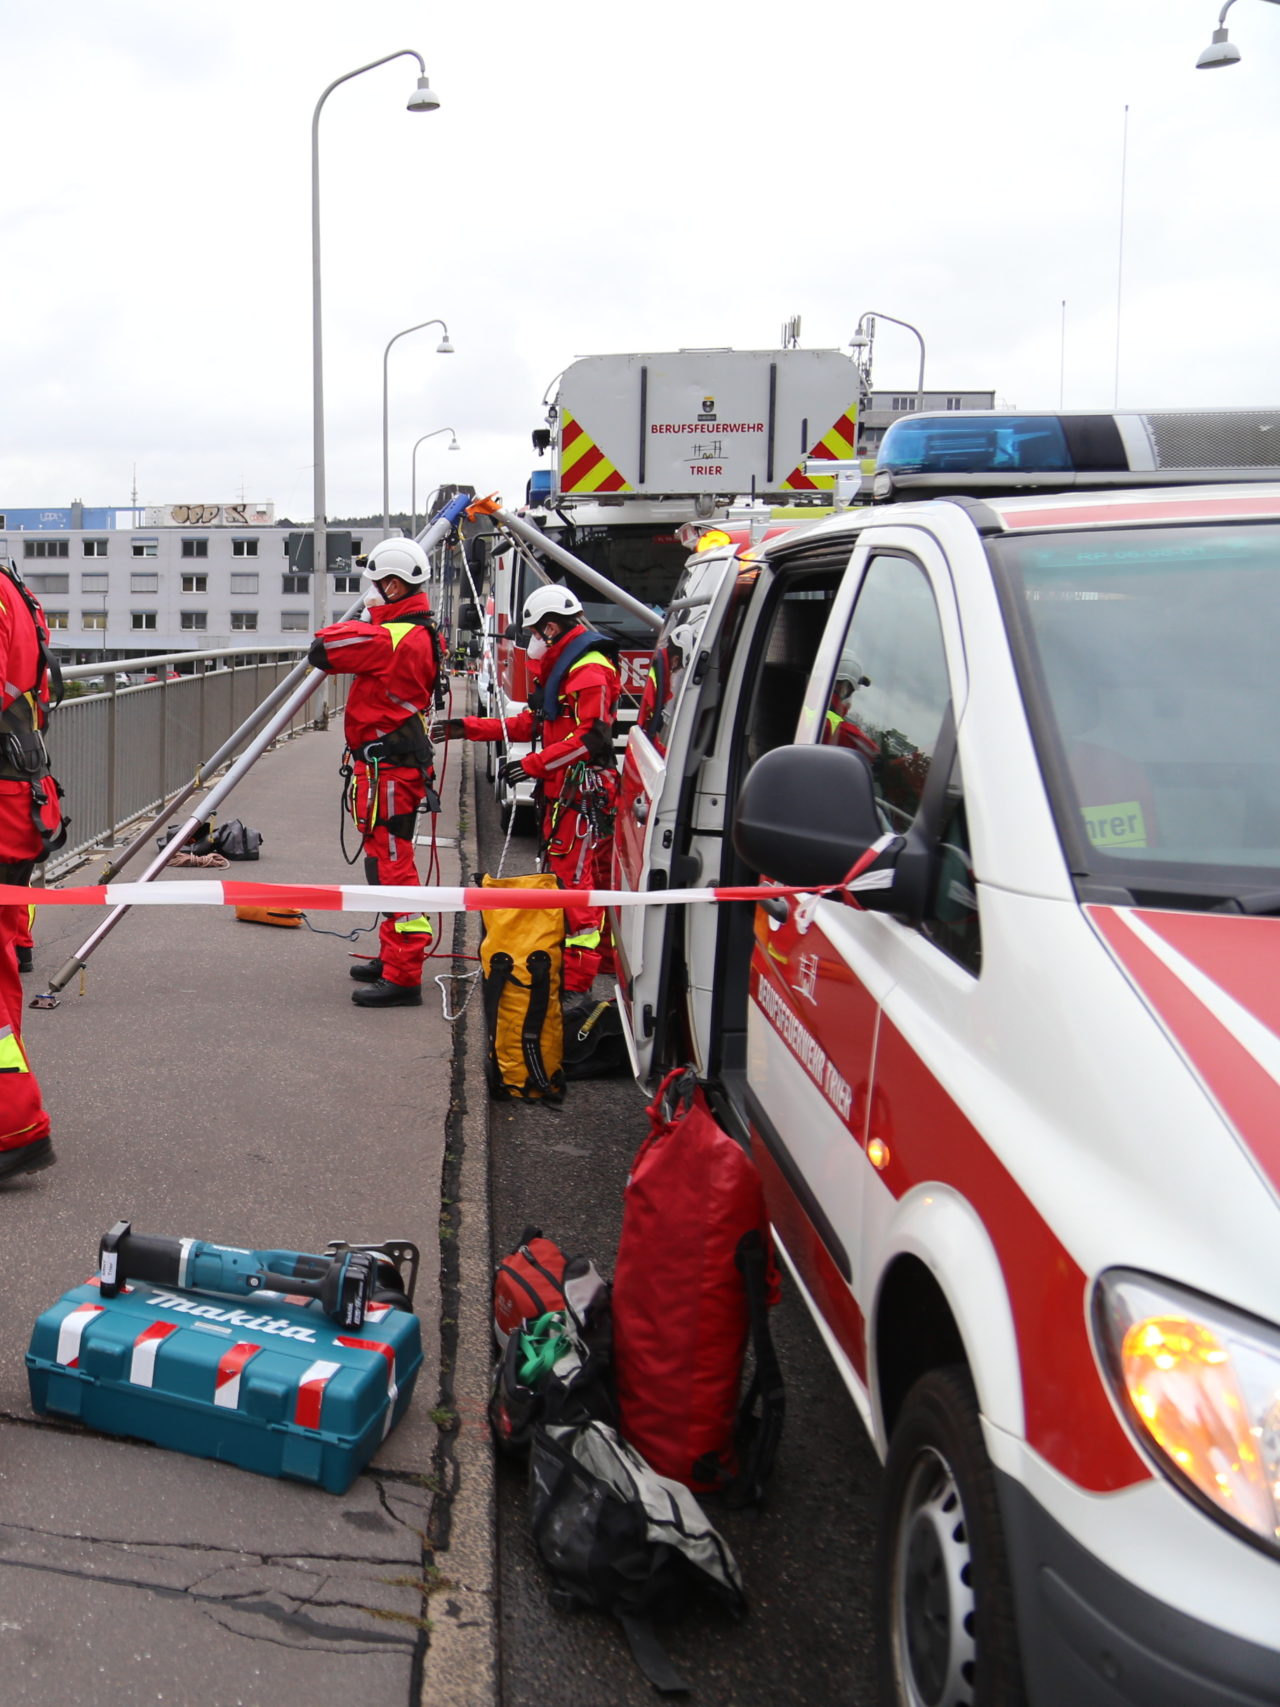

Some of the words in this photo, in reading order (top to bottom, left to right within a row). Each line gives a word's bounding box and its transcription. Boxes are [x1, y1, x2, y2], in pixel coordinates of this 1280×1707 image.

[651, 423, 764, 434] BERUFSFEUERWEHR
[690, 466, 723, 476] TRIER
[824, 1058, 853, 1122] TRIER
